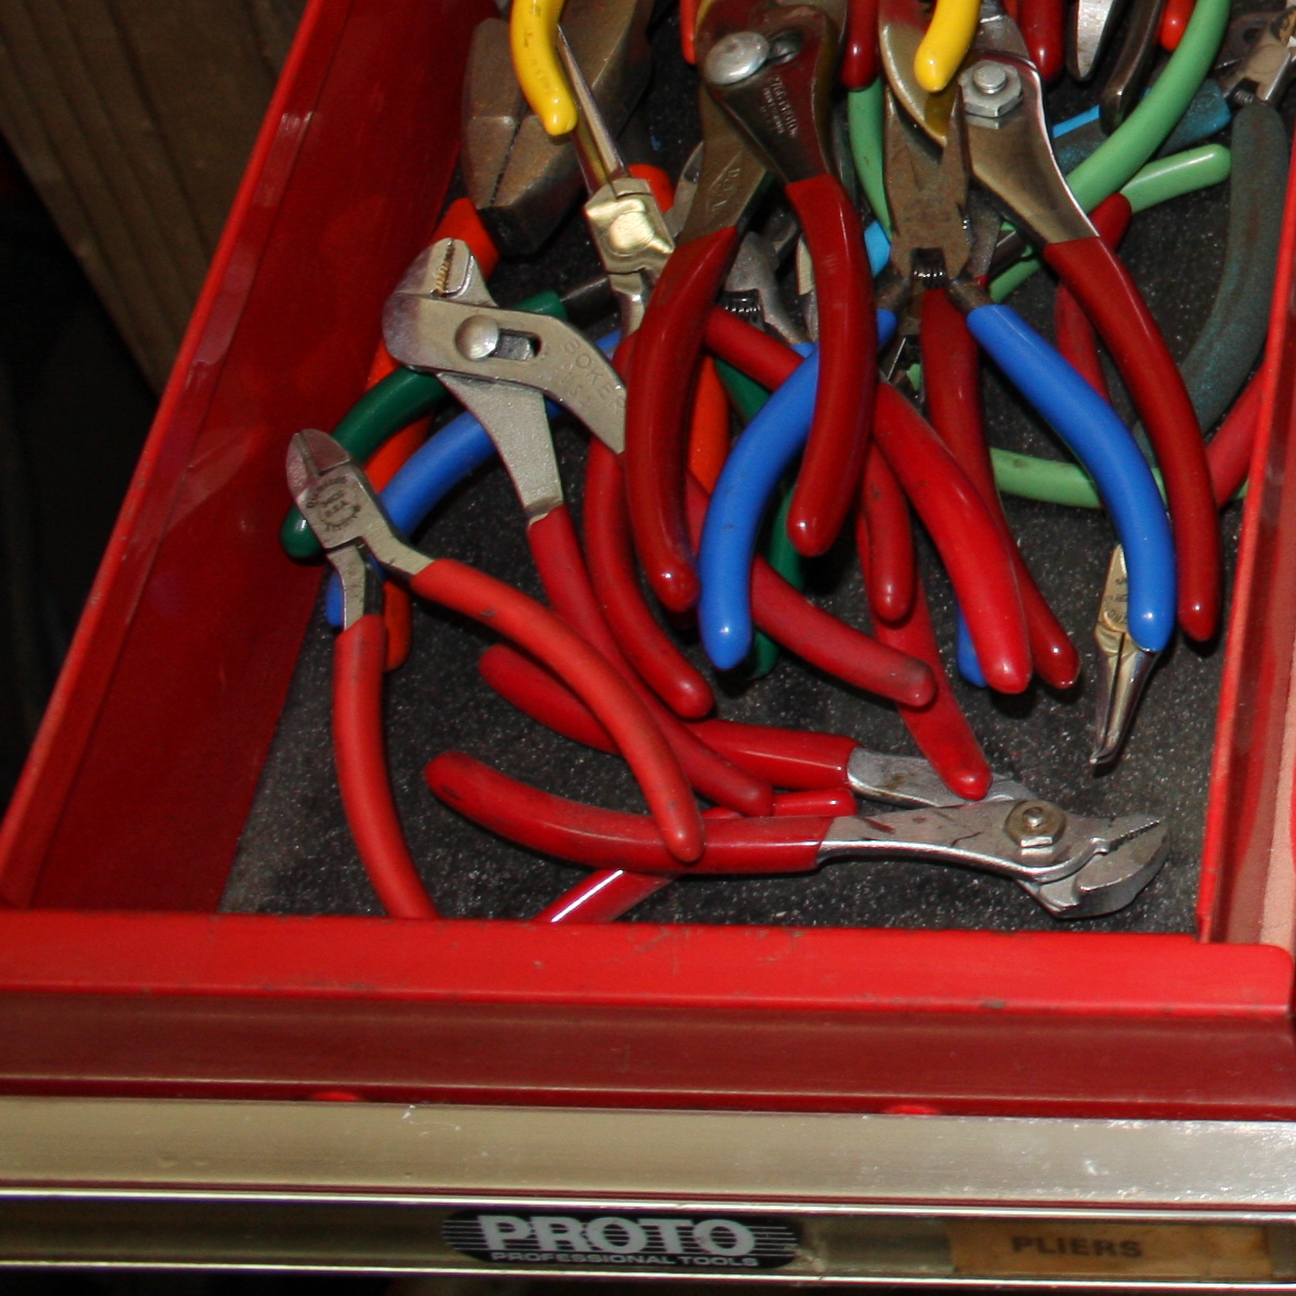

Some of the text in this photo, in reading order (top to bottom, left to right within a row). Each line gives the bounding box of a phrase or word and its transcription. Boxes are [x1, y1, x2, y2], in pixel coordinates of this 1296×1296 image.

[477, 1215, 756, 1256] PROTO
[1012, 1236, 1142, 1258] PLIERS
[491, 1251, 759, 1267] PROFESSIONAL TOOLS
